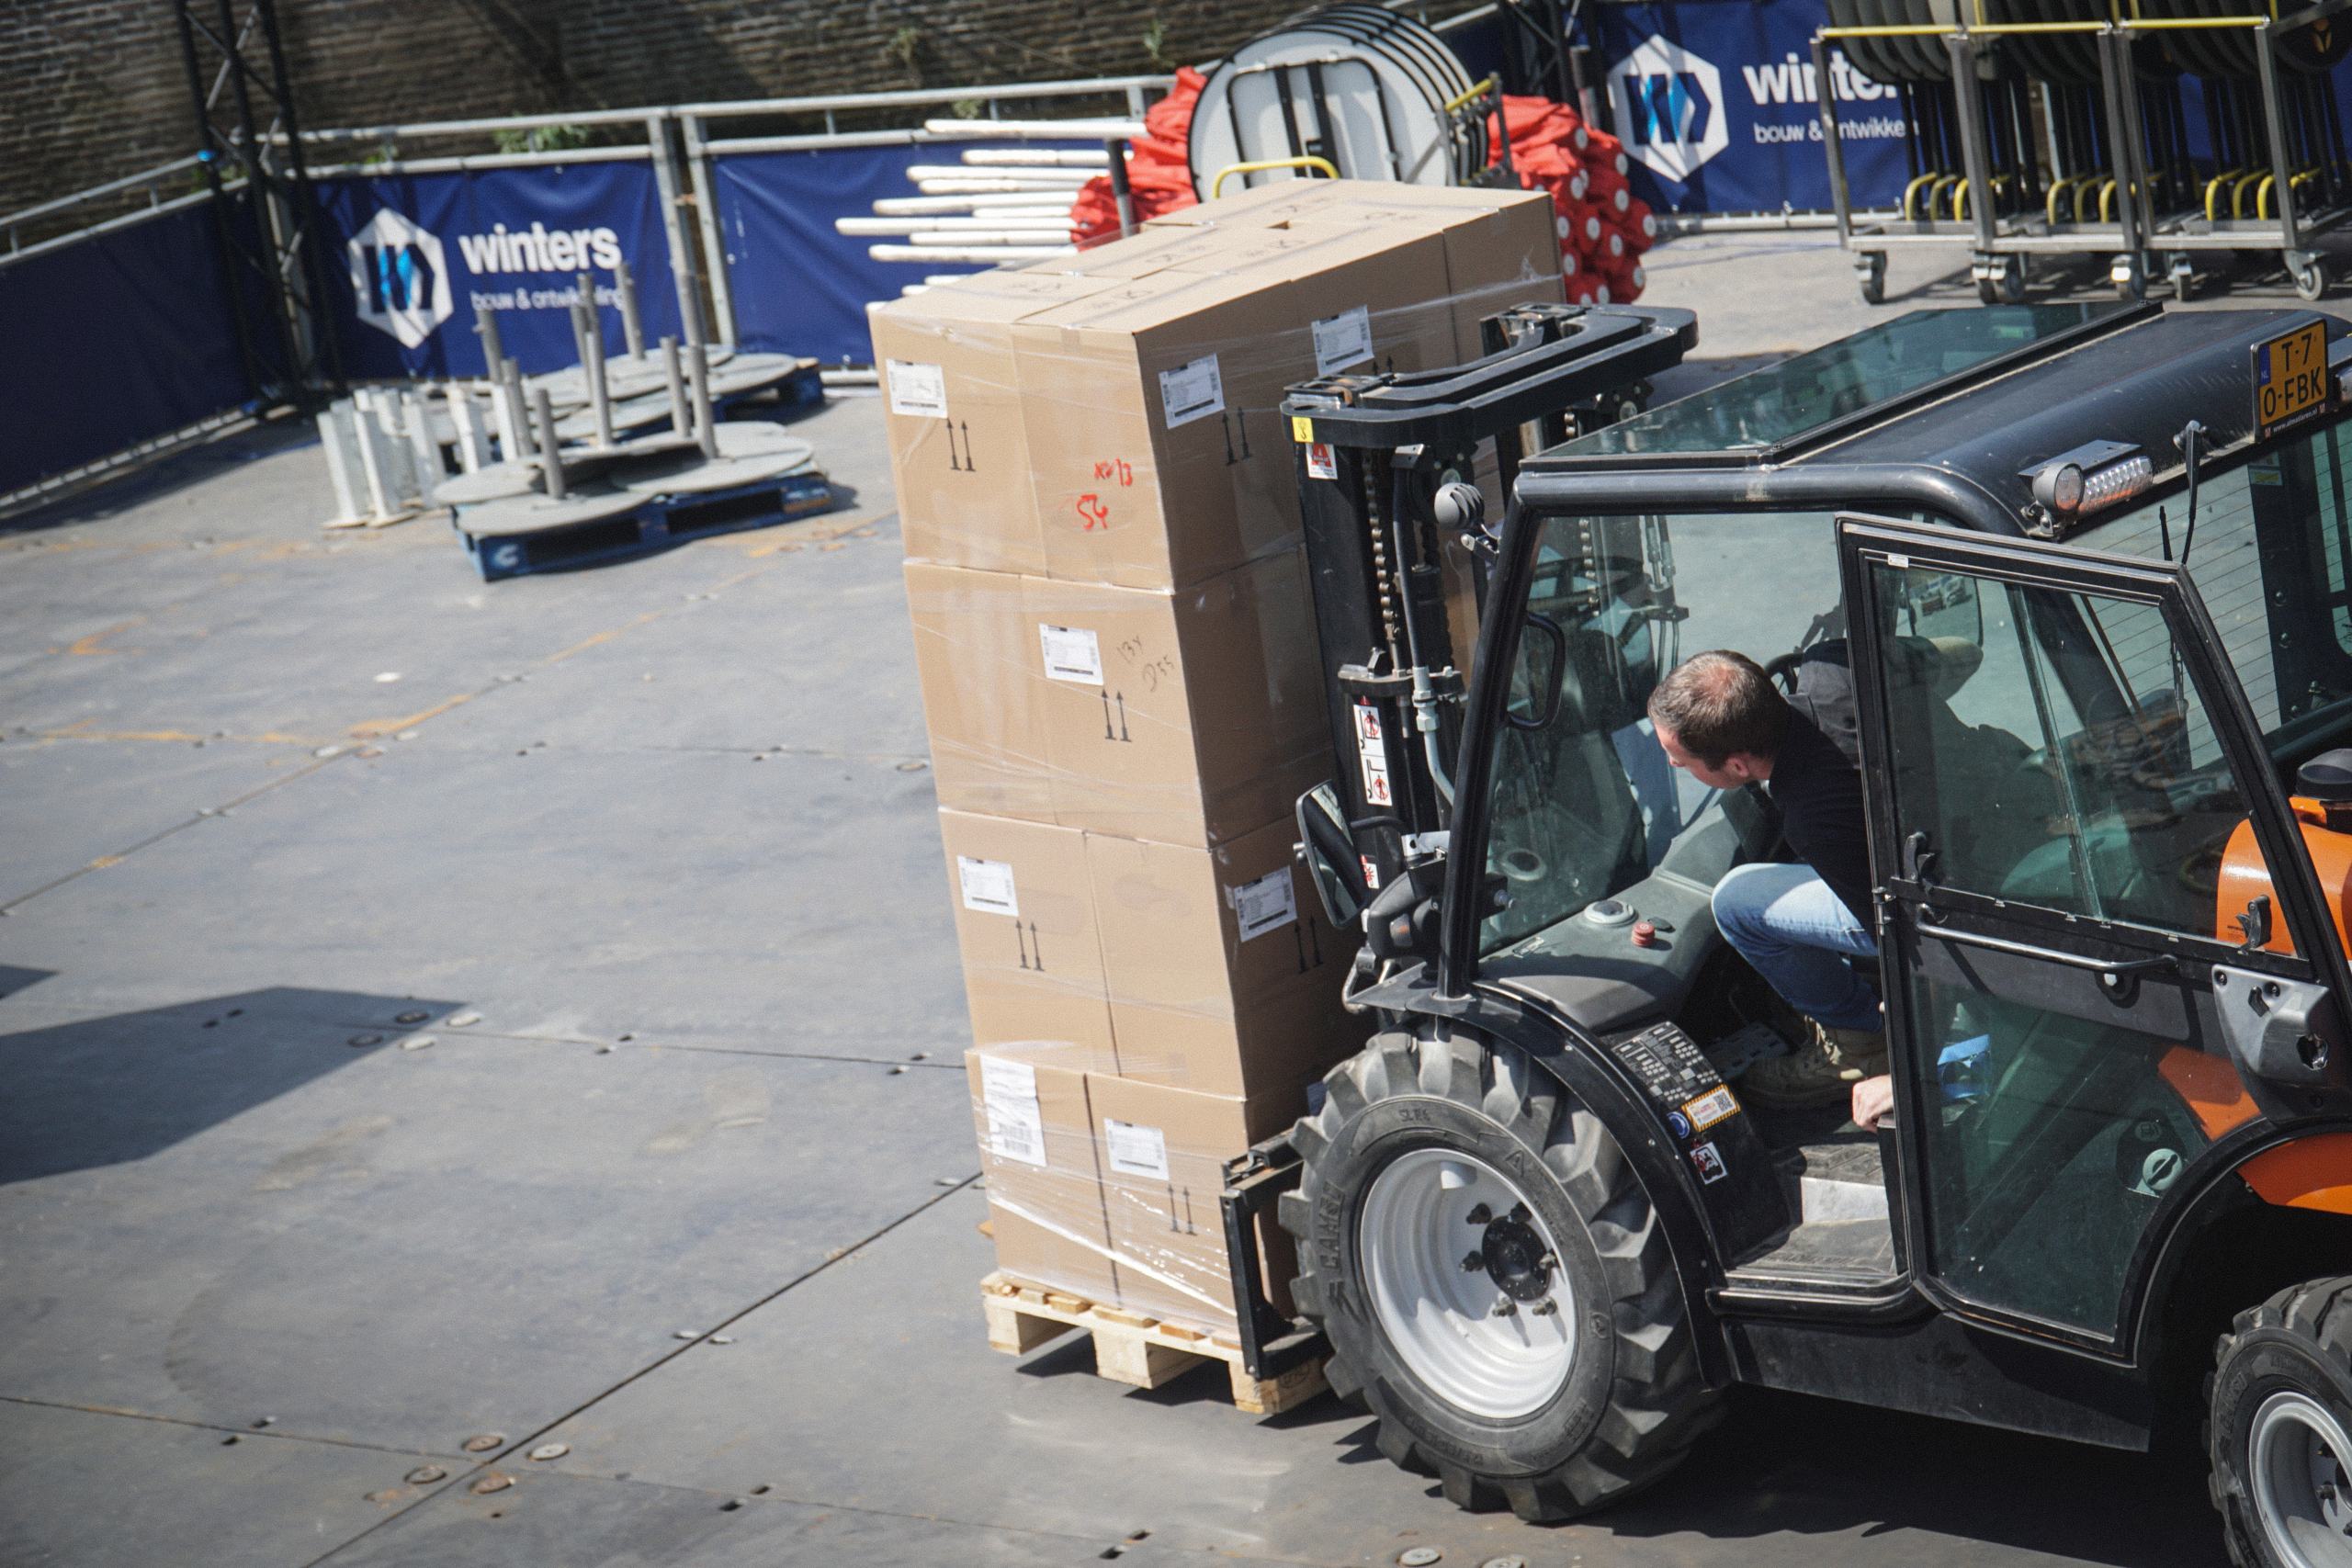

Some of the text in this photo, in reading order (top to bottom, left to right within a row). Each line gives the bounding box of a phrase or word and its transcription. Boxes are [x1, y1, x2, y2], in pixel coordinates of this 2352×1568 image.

[1741, 51, 1913, 105] winte
[1753, 122, 1805, 143] bouw
[1808, 118, 1825, 141] &
[458, 221, 622, 274] winters
[2260, 369, 2269, 380] NL
